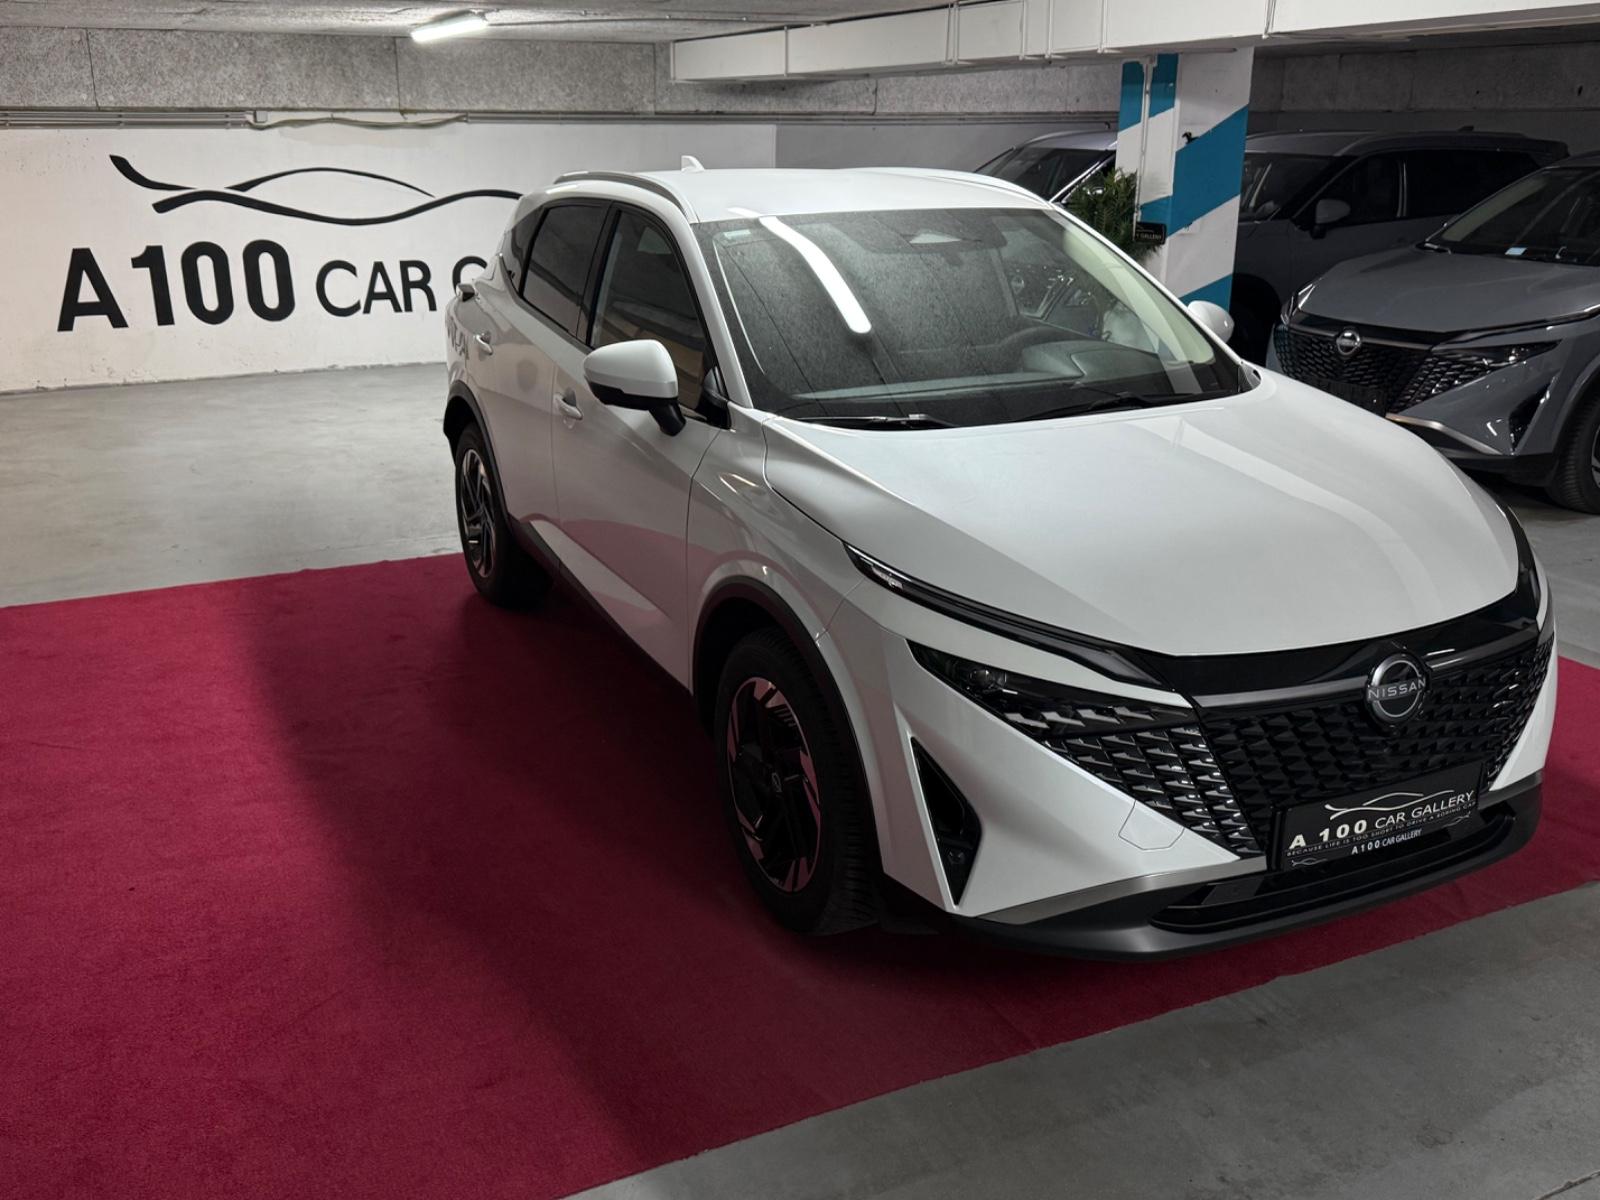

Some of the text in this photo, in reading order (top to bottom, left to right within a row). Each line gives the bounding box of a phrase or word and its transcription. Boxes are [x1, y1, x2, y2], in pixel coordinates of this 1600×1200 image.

[315, 259, 437, 317] CAR
[1367, 677, 1426, 699] NISSAN
[1286, 845, 1322, 857] BECAUSE
[1325, 840, 1341, 849] LIFE
[1352, 833, 1369, 842] TOO
[1370, 826, 1393, 838] SHORT
[1406, 816, 1428, 827] DRIVE
[1462, 801, 1476, 810] CAR
[1375, 812, 1406, 829] CAR
[1411, 790, 1475, 818] GALLERY
[1381, 836, 1395, 847] CAR
[1395, 828, 1423, 843] GALLERY
